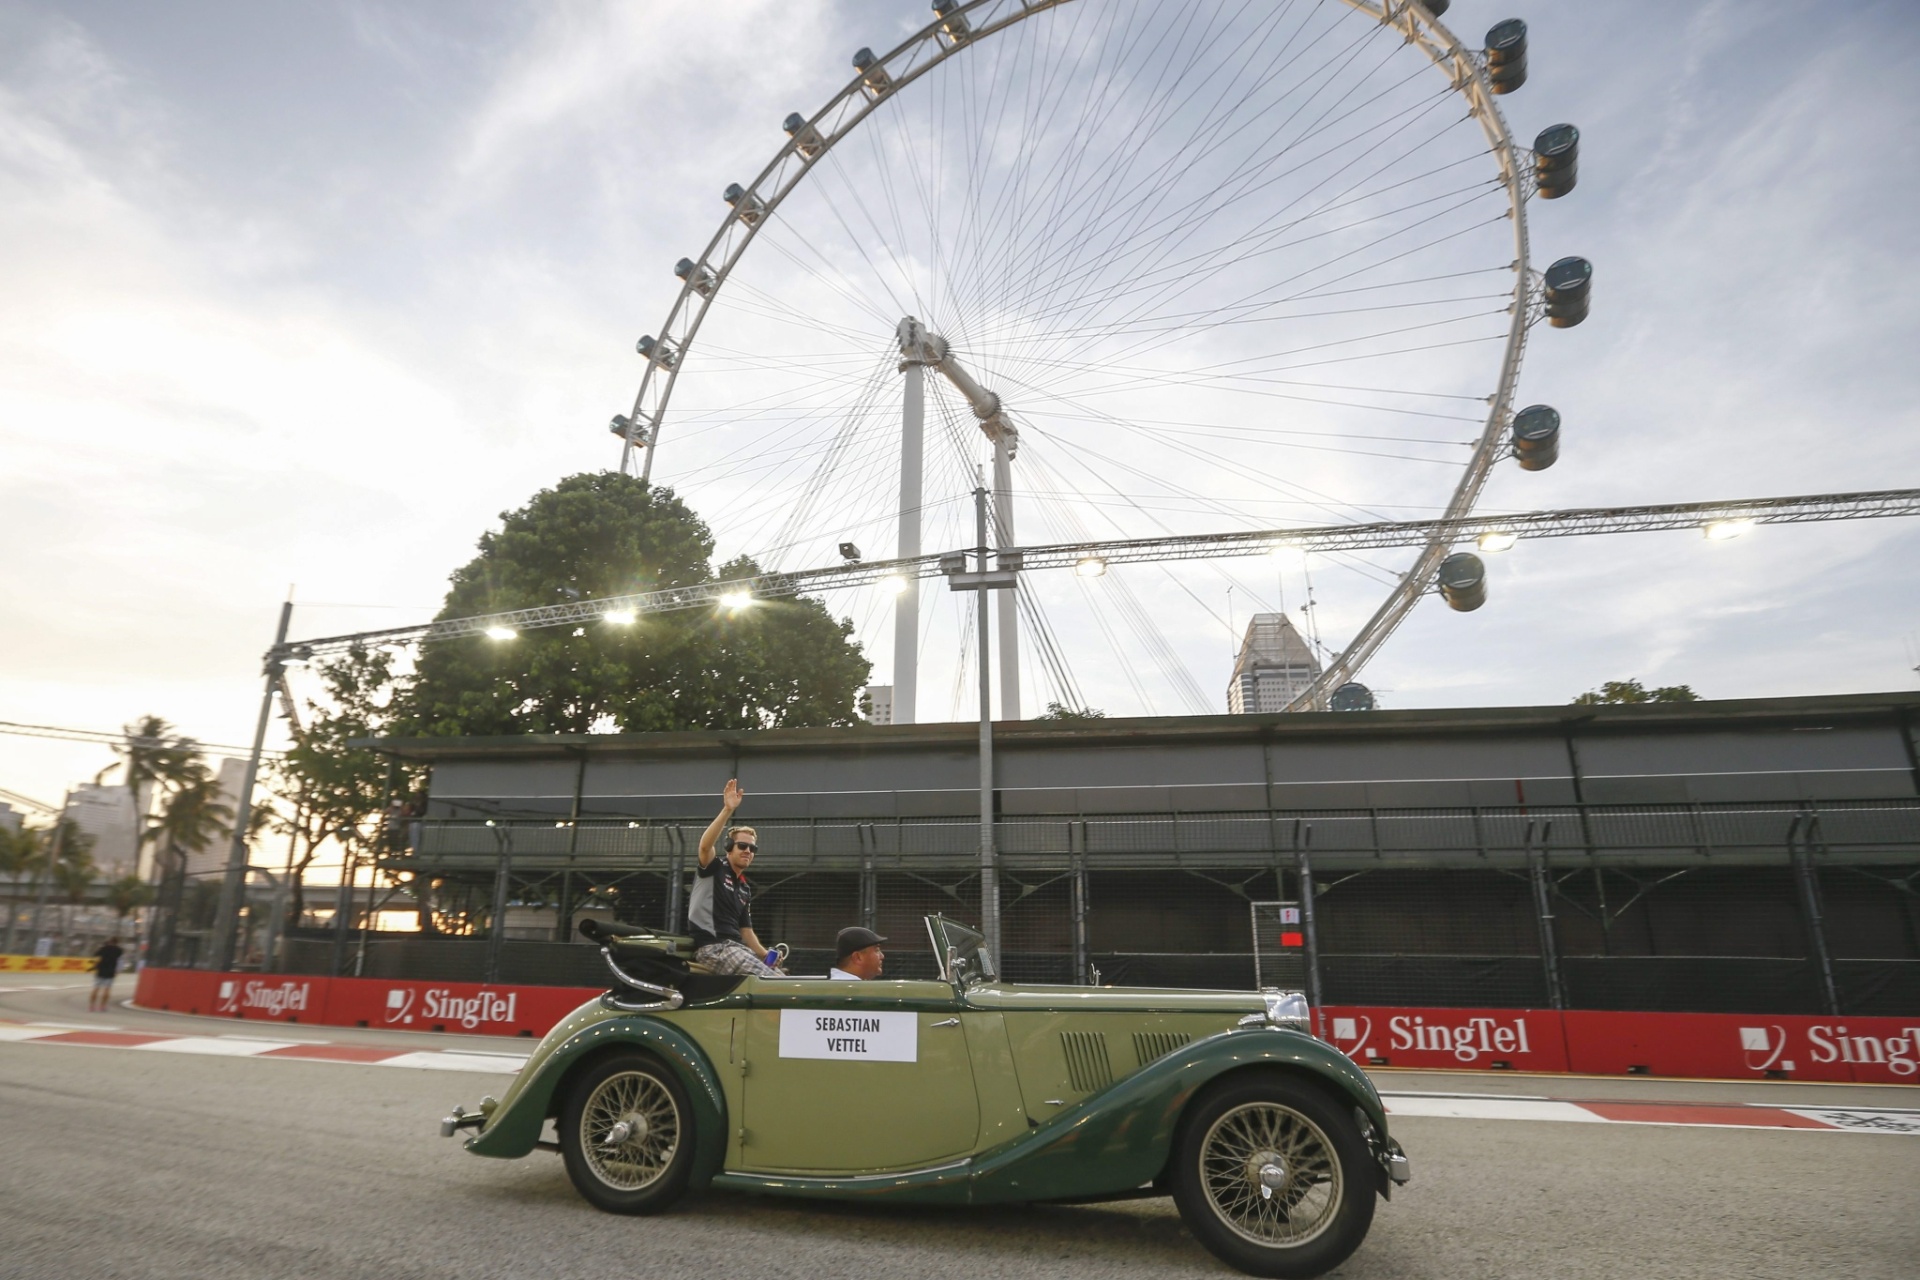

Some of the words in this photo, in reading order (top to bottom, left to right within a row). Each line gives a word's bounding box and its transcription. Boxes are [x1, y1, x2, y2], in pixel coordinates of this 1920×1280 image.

[243, 980, 310, 1015] SingTel
[422, 989, 517, 1029] SingTel
[815, 1017, 880, 1032] SEBASTIAN
[1389, 1016, 1531, 1061] SingTel
[827, 1038, 867, 1052] VETTEL
